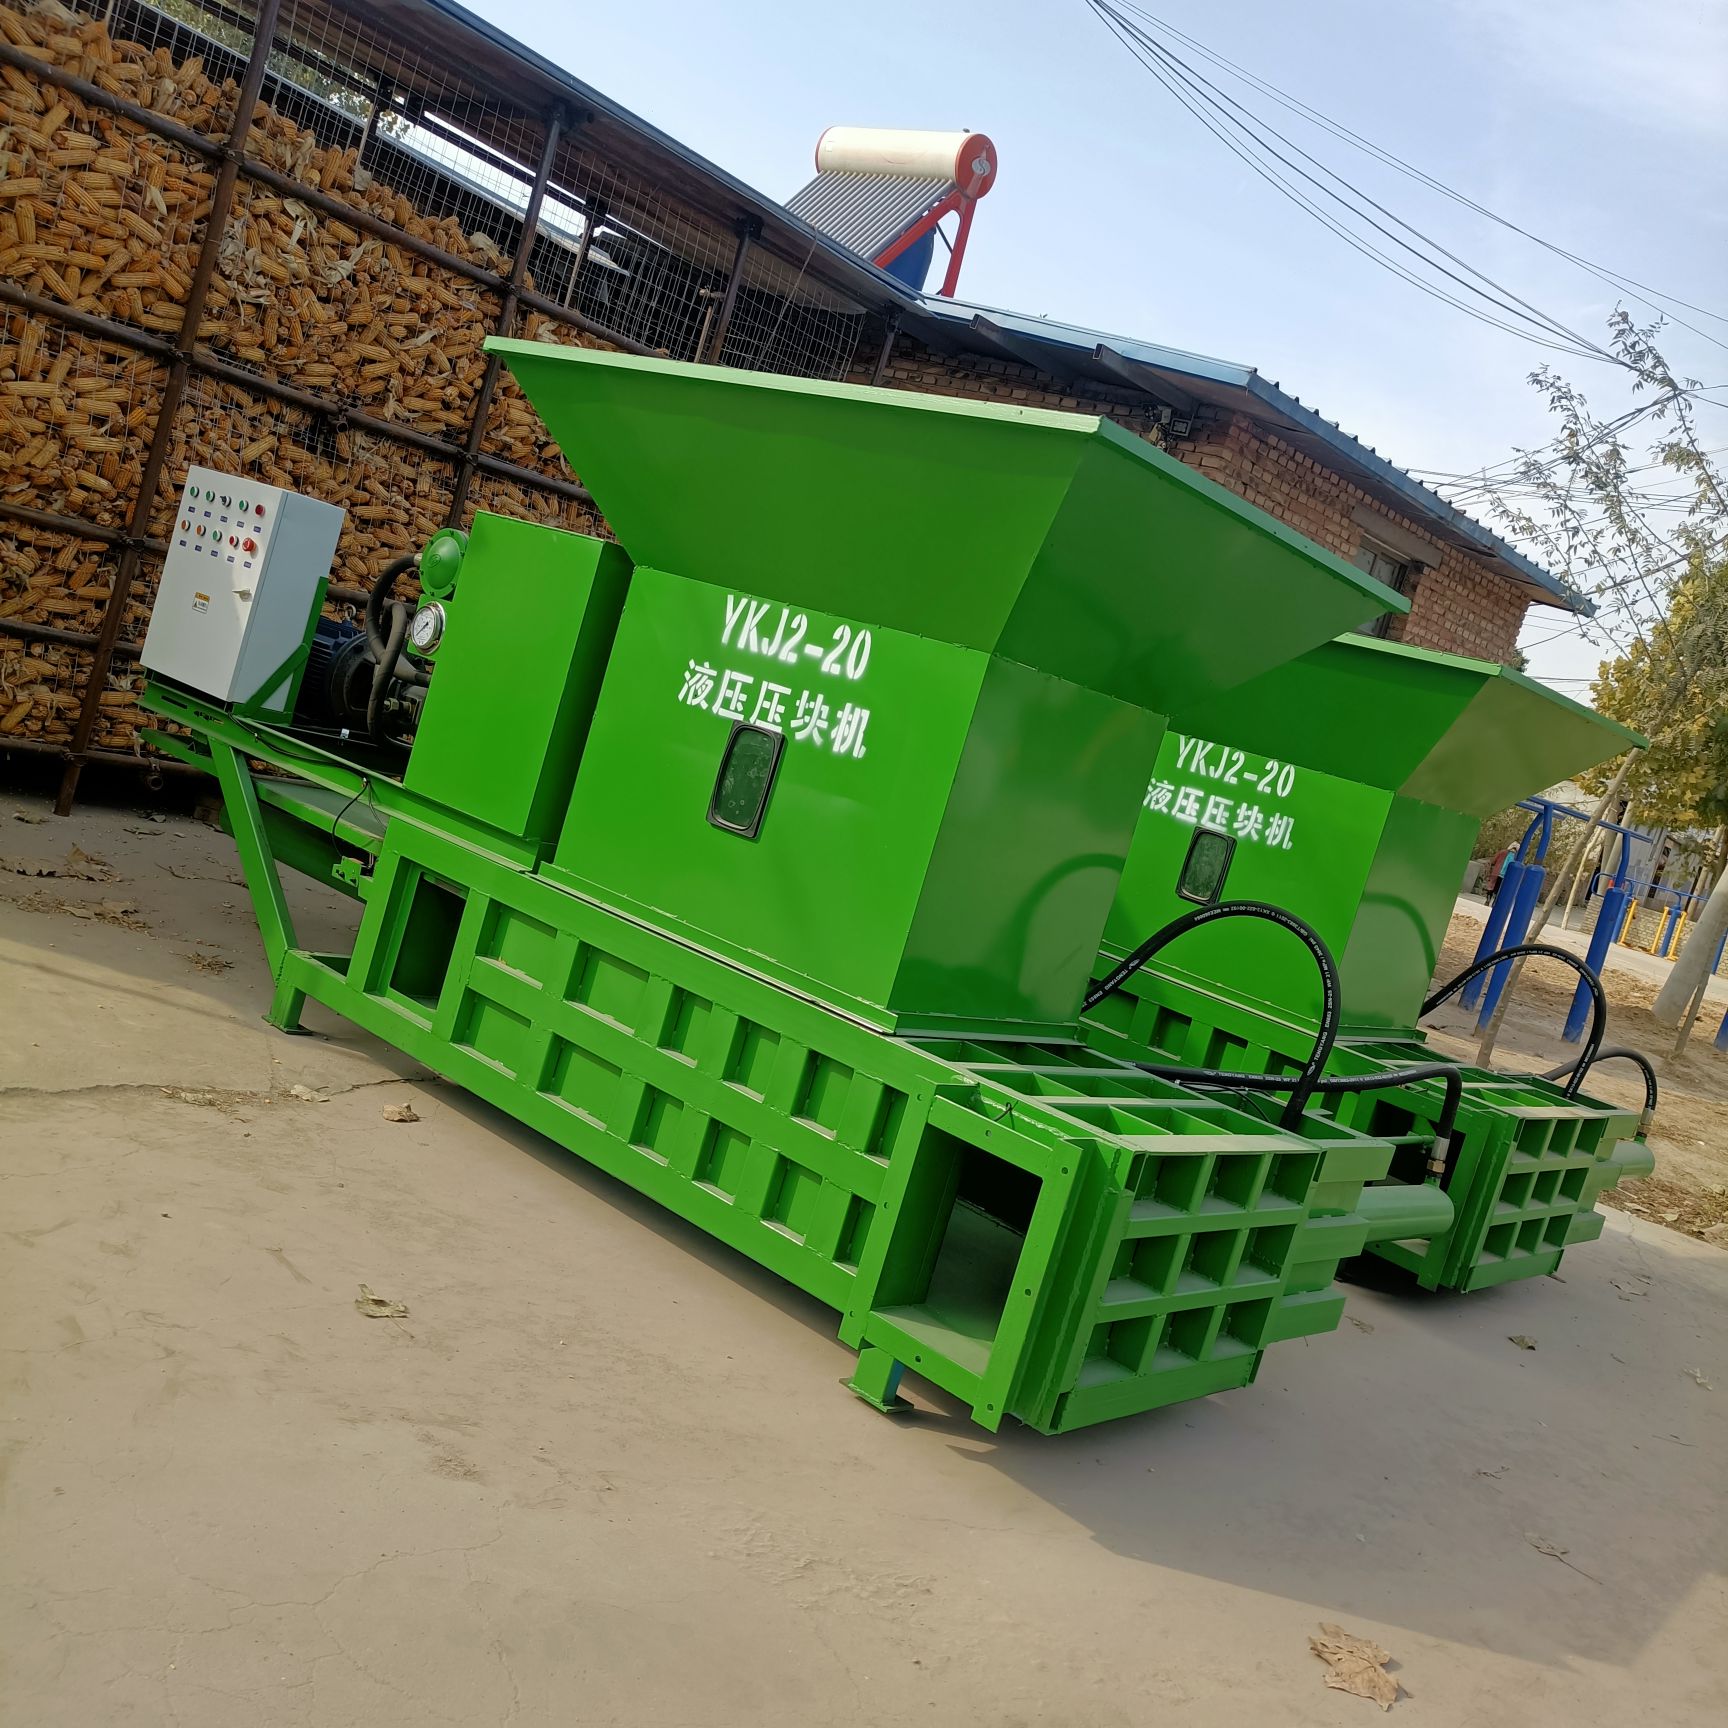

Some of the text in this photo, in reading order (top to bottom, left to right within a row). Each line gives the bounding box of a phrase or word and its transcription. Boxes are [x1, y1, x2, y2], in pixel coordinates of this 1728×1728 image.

[721, 594, 872, 680] YKJ2-20
[678, 658, 871, 759] 液压压块机
[1176, 735, 1296, 797] YKJ2-20
[1143, 777, 1295, 850] 液压压块机
